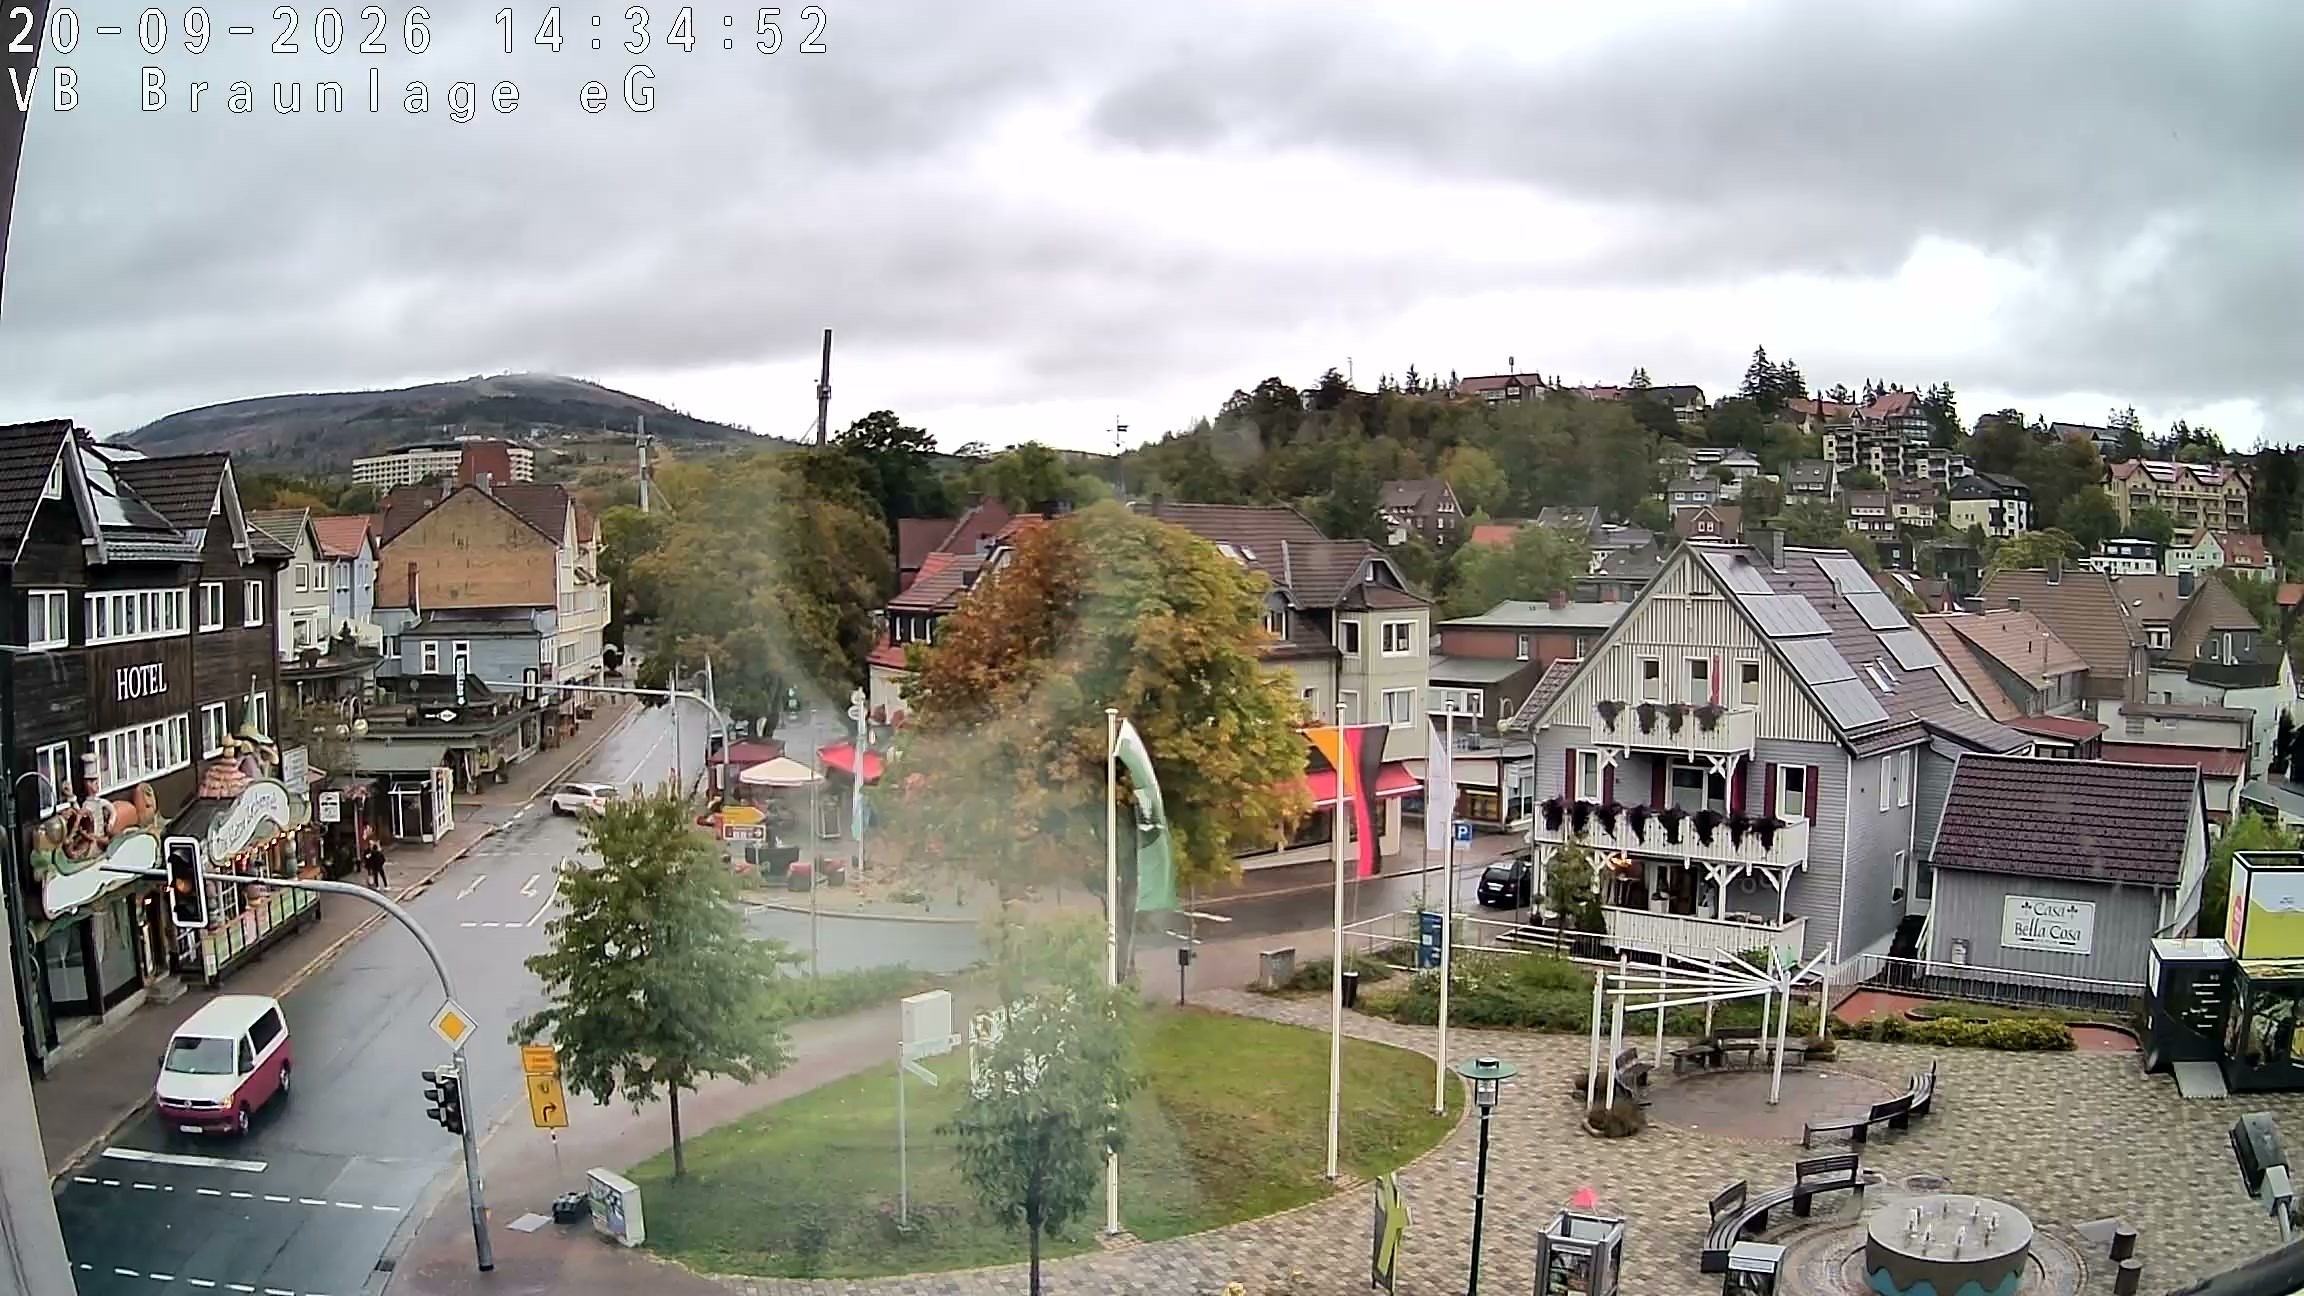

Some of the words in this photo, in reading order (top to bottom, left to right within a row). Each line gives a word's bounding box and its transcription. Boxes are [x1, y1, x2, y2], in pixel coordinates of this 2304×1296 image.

[116, 663, 167, 701] HOTEL
[1458, 826, 1467, 839] P
[2033, 902, 2066, 917] Casa
[2014, 918, 2046, 938] Bella
[2049, 925, 2081, 941] Cosa
